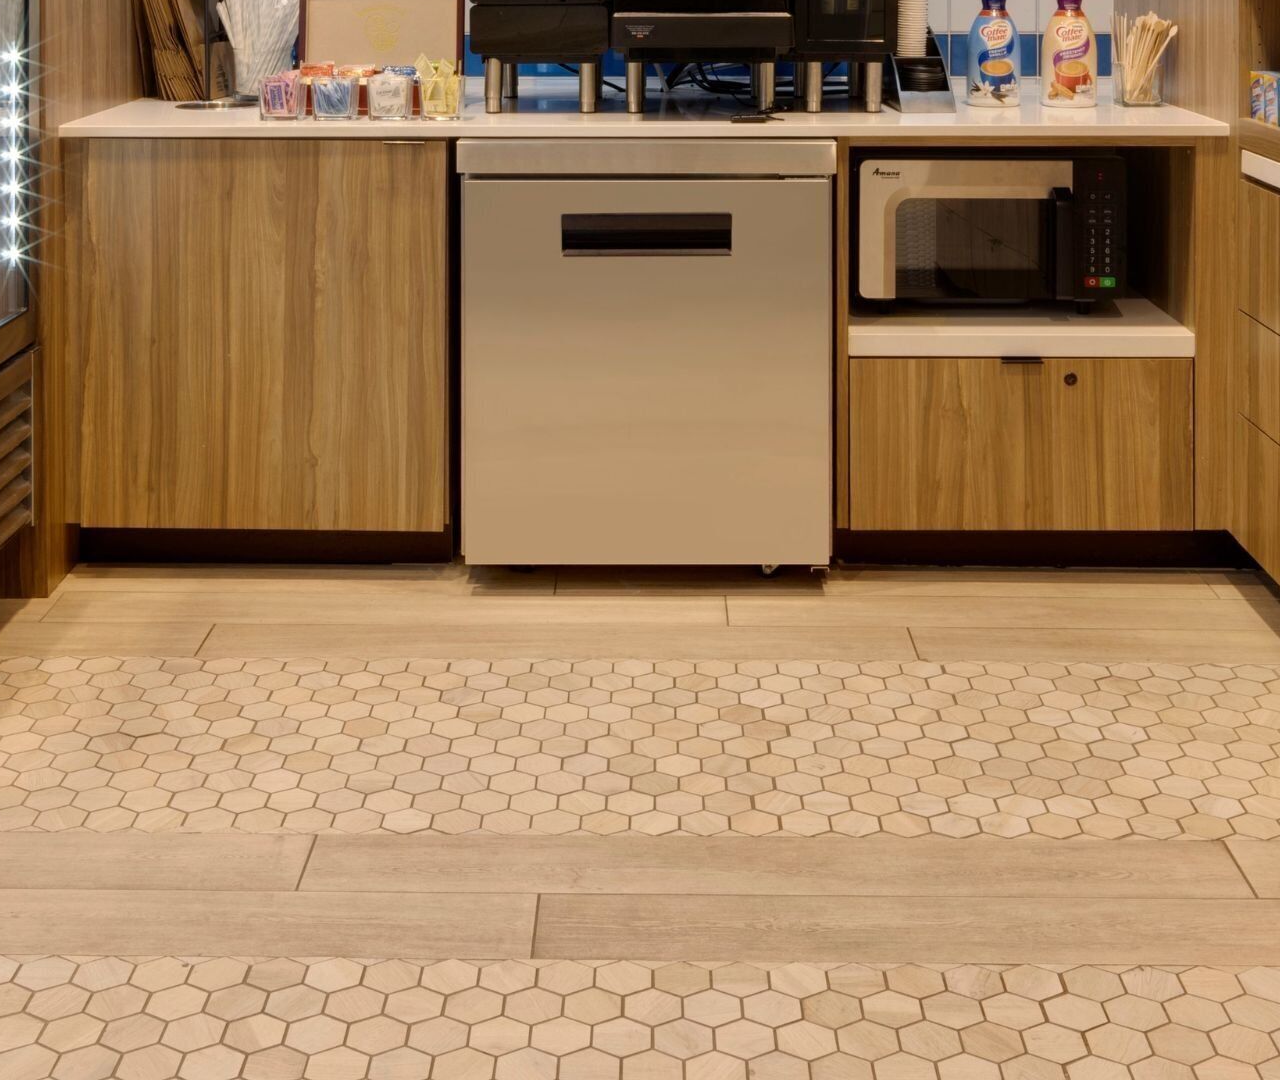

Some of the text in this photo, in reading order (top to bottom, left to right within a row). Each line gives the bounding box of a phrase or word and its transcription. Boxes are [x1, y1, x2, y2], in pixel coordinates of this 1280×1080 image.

[980, 25, 1009, 38] Coffee
[1055, 25, 1084, 38] Coffee
[987, 34, 1008, 42] mate
[1062, 34, 1083, 42] mate
[872, 167, 901, 177] Amana
